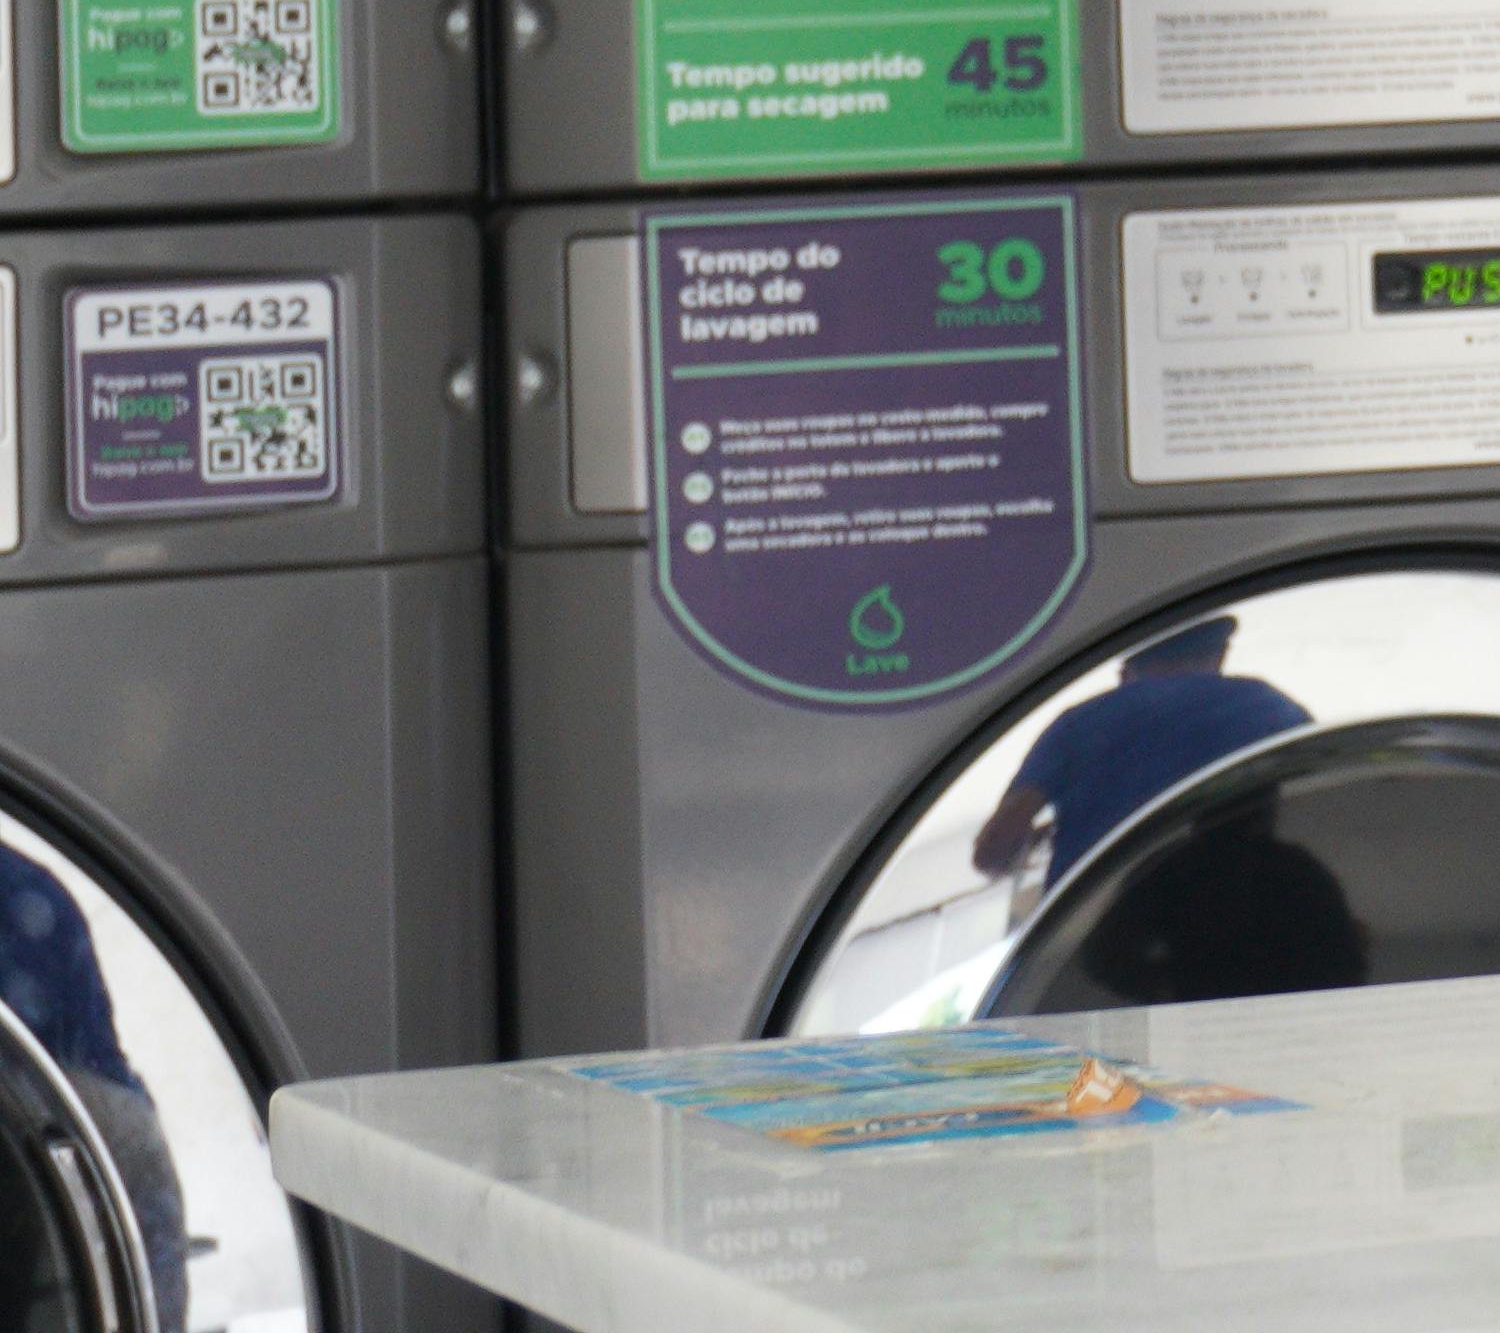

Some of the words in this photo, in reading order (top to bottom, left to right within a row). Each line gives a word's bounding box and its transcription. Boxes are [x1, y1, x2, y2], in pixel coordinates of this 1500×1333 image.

[665, 60, 778, 91] Tempo
[783, 52, 925, 89] sugerido
[946, 34, 1049, 92] 45
[666, 96, 741, 127] para
[746, 90, 889, 120] secagem
[677, 243, 788, 280] Tempo
[796, 242, 842, 269] do
[936, 237, 1045, 303] 30
[677, 281, 757, 310] ciclo
[761, 277, 805, 304] de
[97, 297, 311, 338] PE34-432
[679, 310, 820, 345] lavagem
[842, 653, 911, 676] Lave
